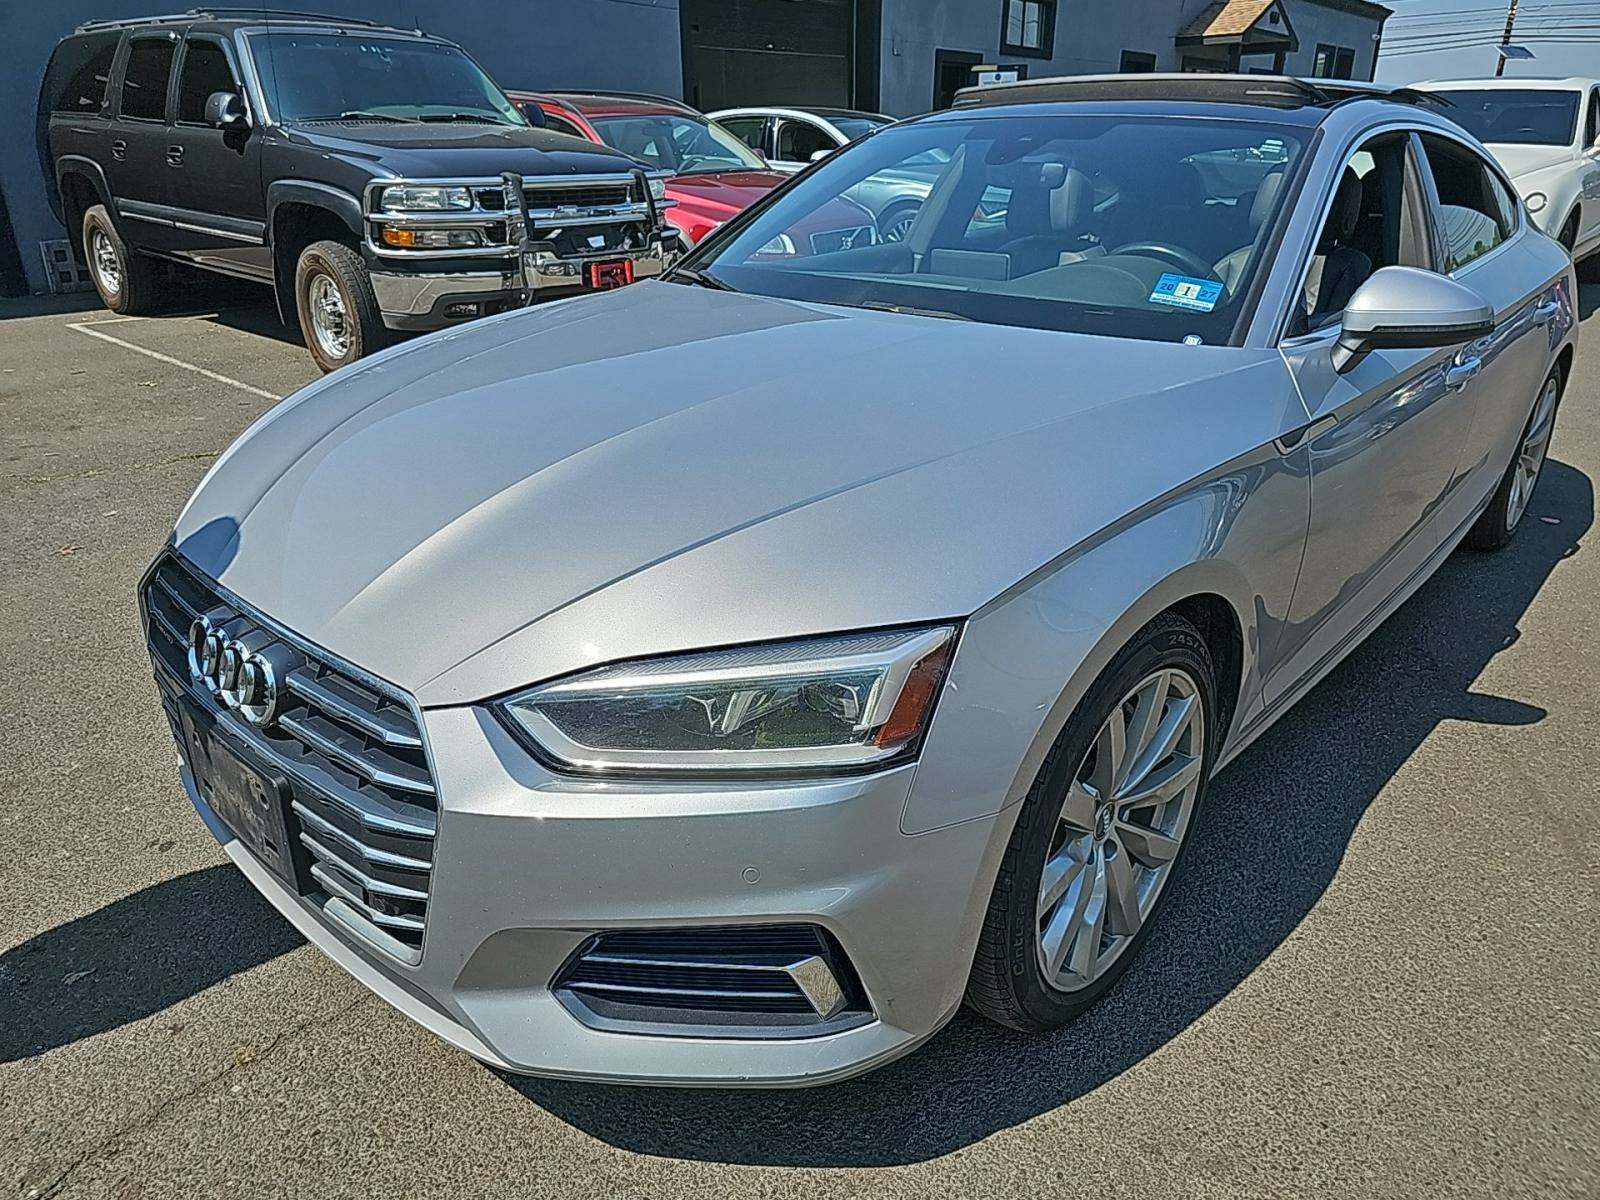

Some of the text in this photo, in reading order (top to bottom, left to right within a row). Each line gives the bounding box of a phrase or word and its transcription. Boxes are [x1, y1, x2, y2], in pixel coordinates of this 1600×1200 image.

[1160, 282, 1217, 299] 20 1 27
